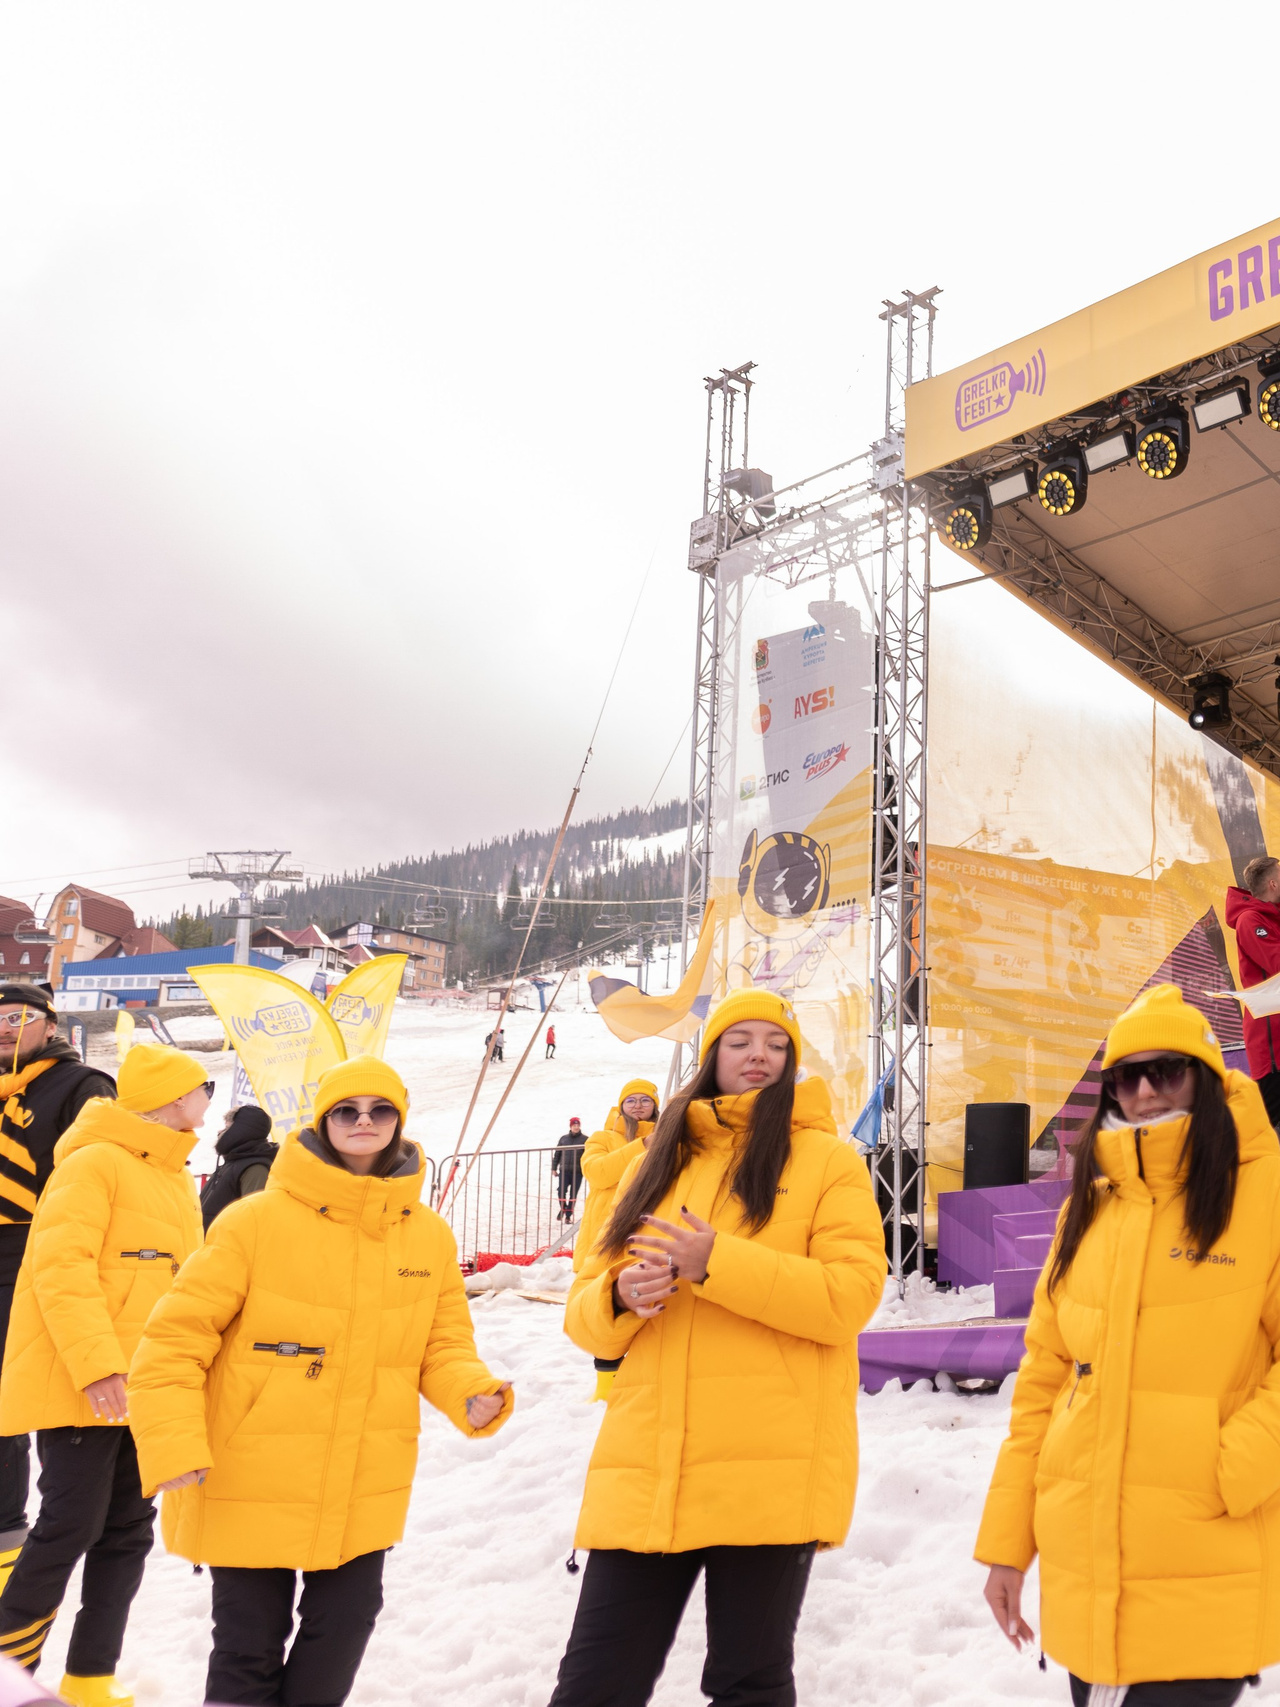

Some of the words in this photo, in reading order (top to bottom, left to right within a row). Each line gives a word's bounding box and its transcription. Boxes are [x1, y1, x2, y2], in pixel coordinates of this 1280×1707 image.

[964, 370, 1006, 404] GRELKA
[964, 396, 992, 423] FEST
[794, 685, 835, 720] AYS!
[759, 769, 790, 790] 2ГИС
[927, 858, 1007, 881] СОГРЕВАЕМ
[1011, 871, 1020, 883] В
[1022, 872, 1089, 893] ШЕРЕГЕШЕ
[1092, 883, 1118, 898] УЖЕ
[1122, 888, 1133, 901] 10
